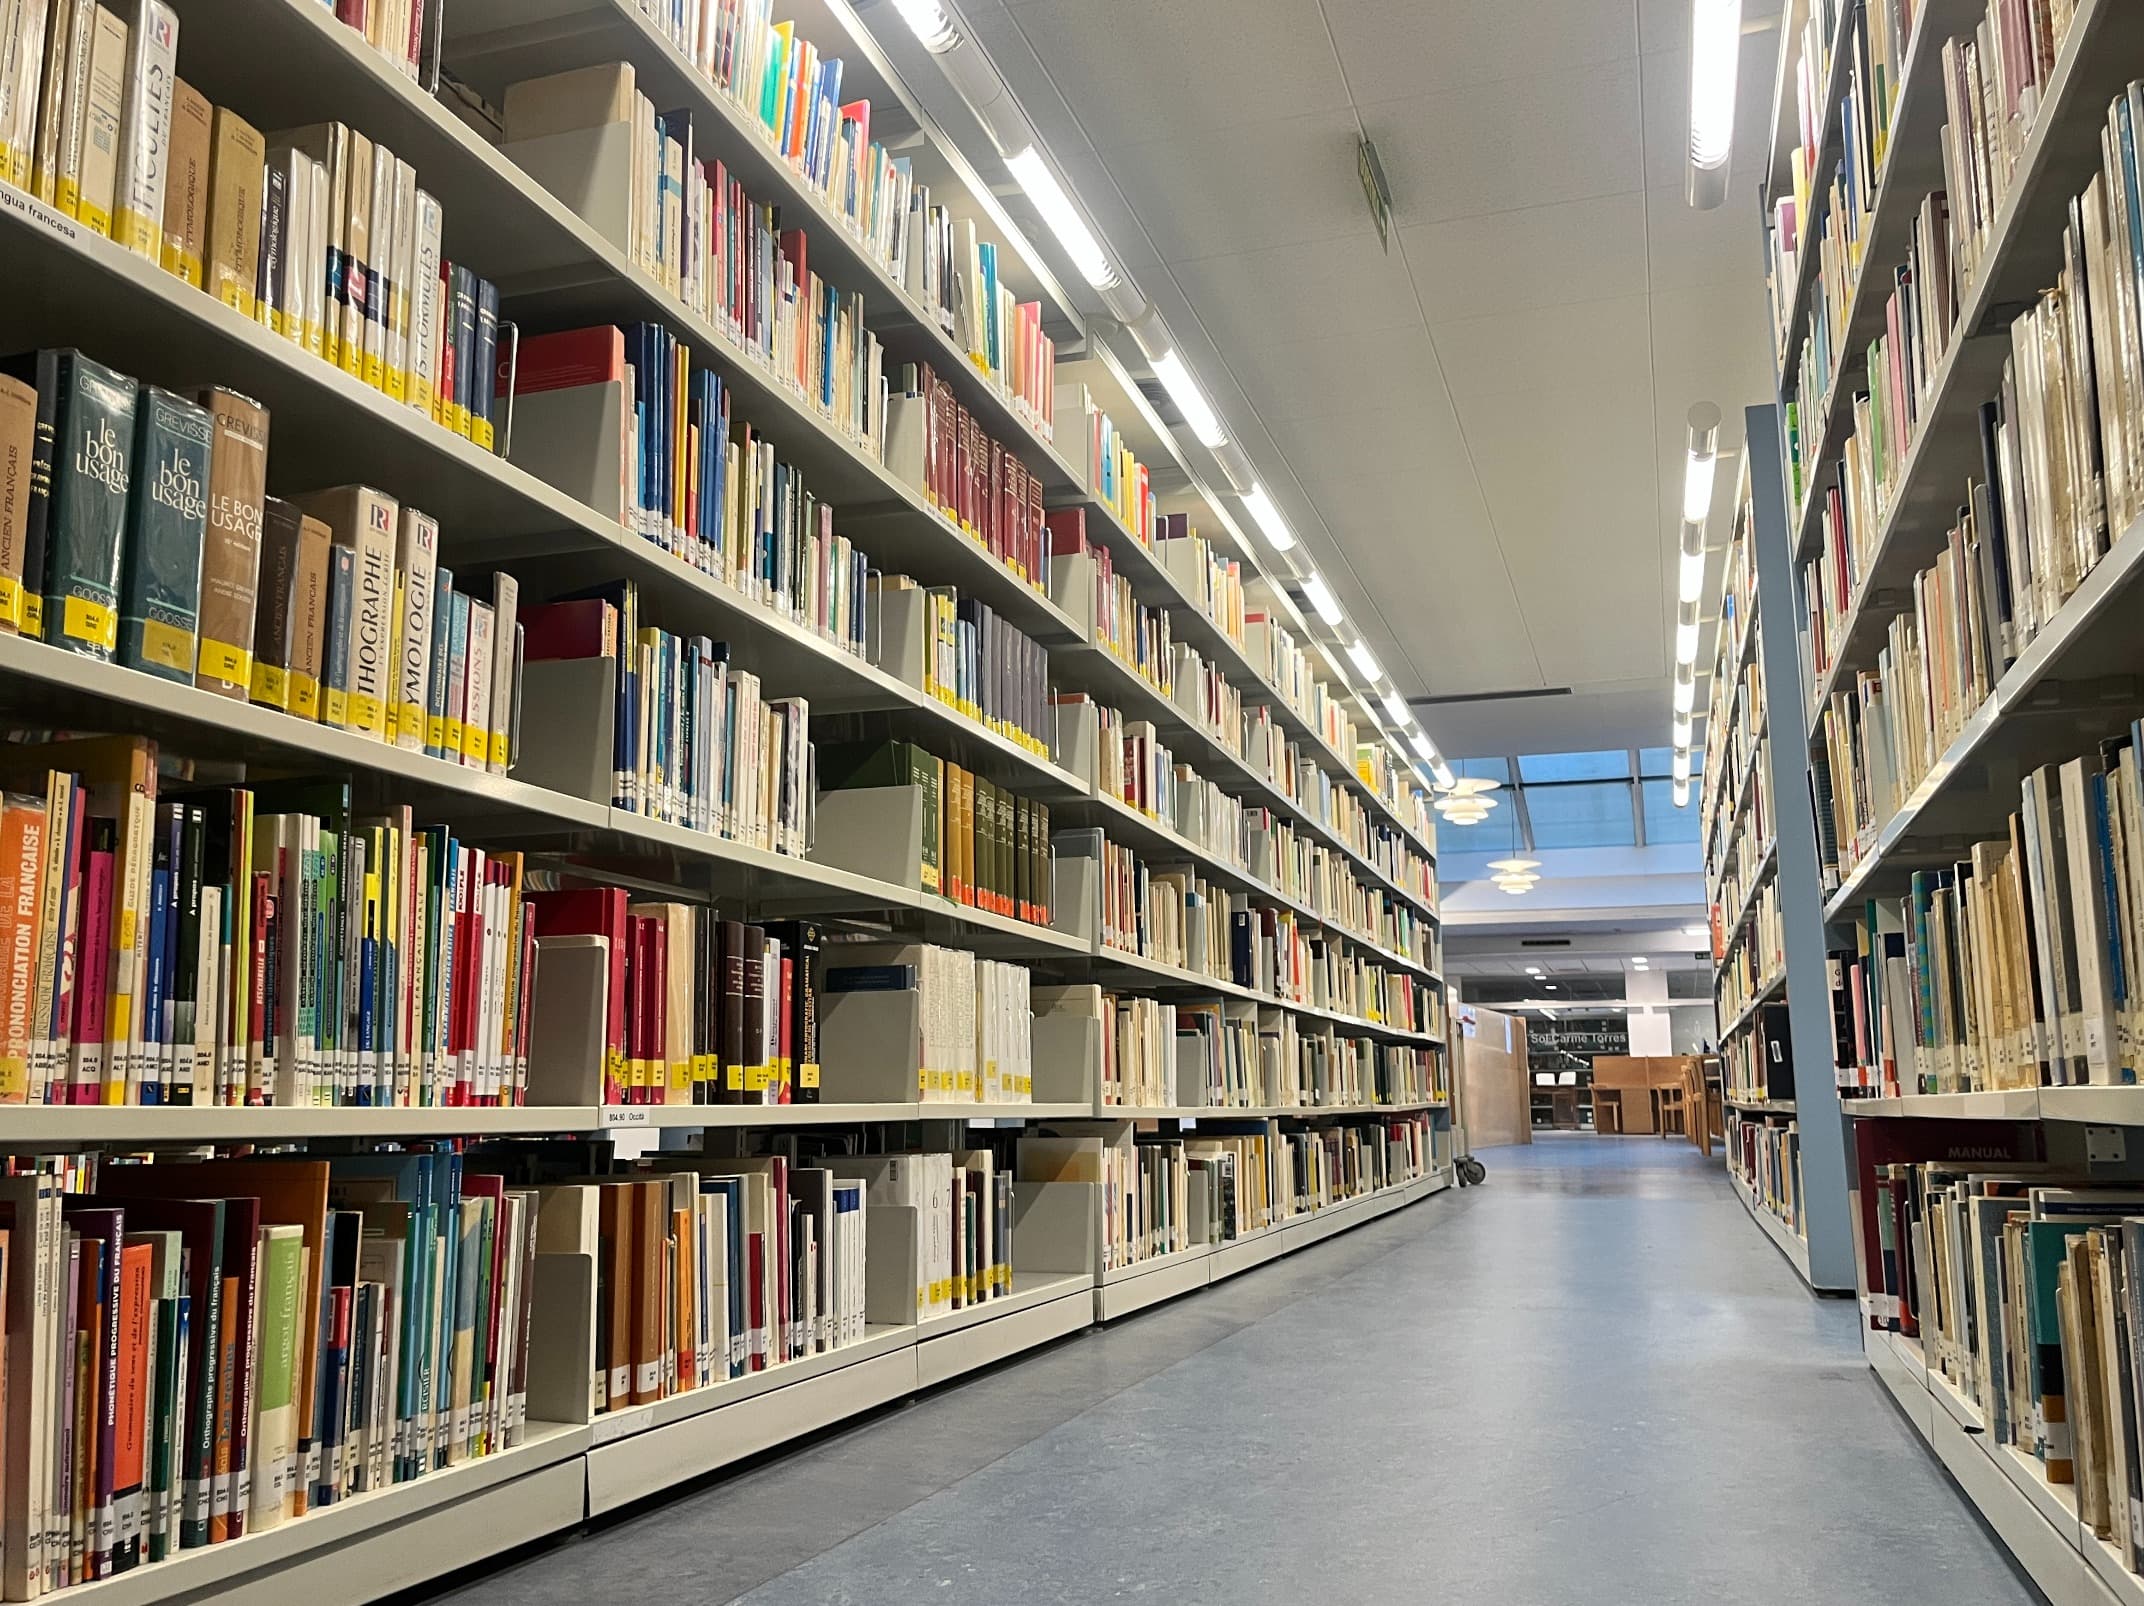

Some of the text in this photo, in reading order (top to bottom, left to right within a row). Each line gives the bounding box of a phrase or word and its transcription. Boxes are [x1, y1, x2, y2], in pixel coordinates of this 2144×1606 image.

[28, 203, 77, 240] francesa
[86, 430, 124, 472] bon
[100, 418, 116, 447] le
[76, 452, 129, 494] usage
[160, 460, 200, 498] bon
[174, 448, 191, 476] le
[152, 481, 207, 520] usage
[211, 493, 263, 521] LE BON
[1, 516, 13, 571] ANCIEN
[211, 512, 262, 542] USAGE
[8, 824, 40, 1059] PRONONCIATION FRANÇAISE
[1551, 1033, 1588, 1044] Carme
[1591, 1033, 1626, 1044] Torres
[1948, 1146, 2012, 1159] MANUAL
[108, 1214, 122, 1426] PHONÉTIQUE PROGRESSIVE DU FRANÇAIS
[244, 1307, 253, 1369] progressive
[202, 1266, 220, 1449] Orthographe progressive du français
[240, 1371, 250, 1437] Orthographe
